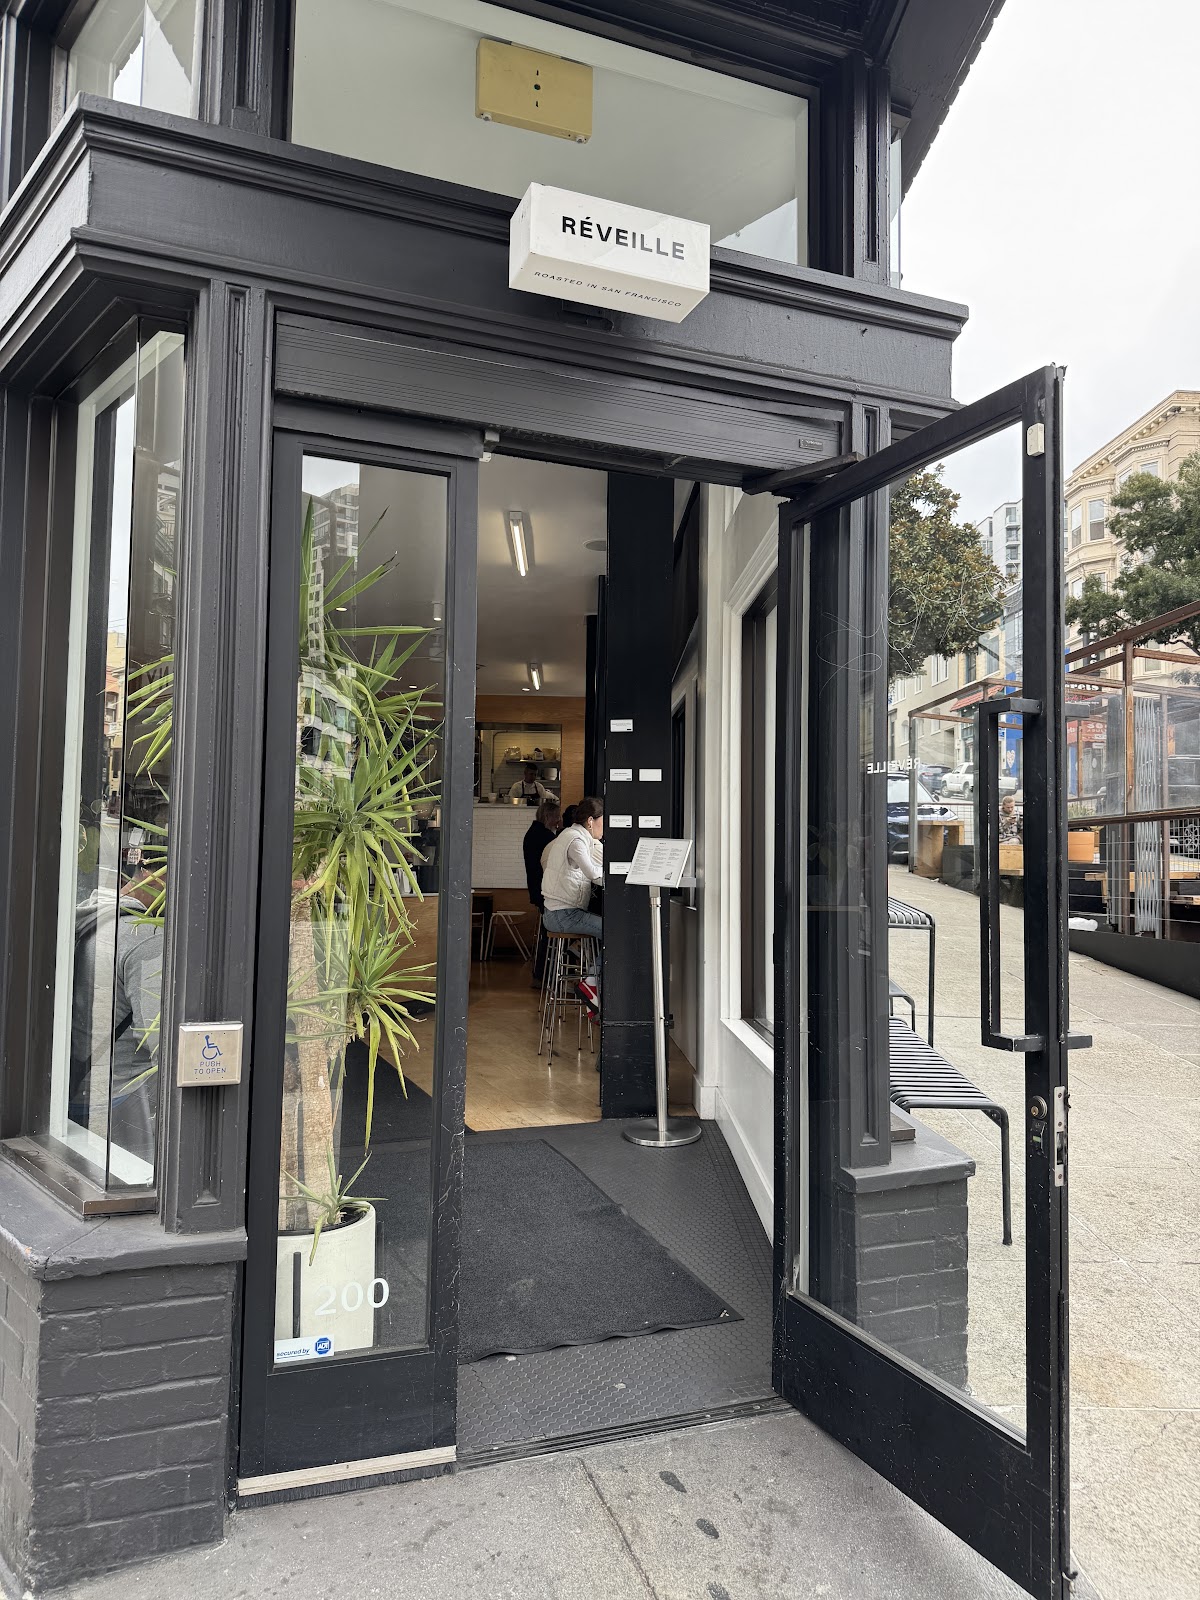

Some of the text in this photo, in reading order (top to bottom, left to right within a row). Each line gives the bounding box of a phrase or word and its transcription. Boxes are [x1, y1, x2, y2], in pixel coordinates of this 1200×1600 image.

[562, 216, 685, 261] RÉVEILLE
[534, 271, 583, 286] ROASTED
[601, 286, 621, 294] SAN
[624, 291, 682, 307] FRANCISCO
[199, 1060, 221, 1068] PUSH
[205, 1067, 227, 1075] OPEN
[314, 1277, 390, 1316] 200
[276, 1348, 302, 1357] secured
